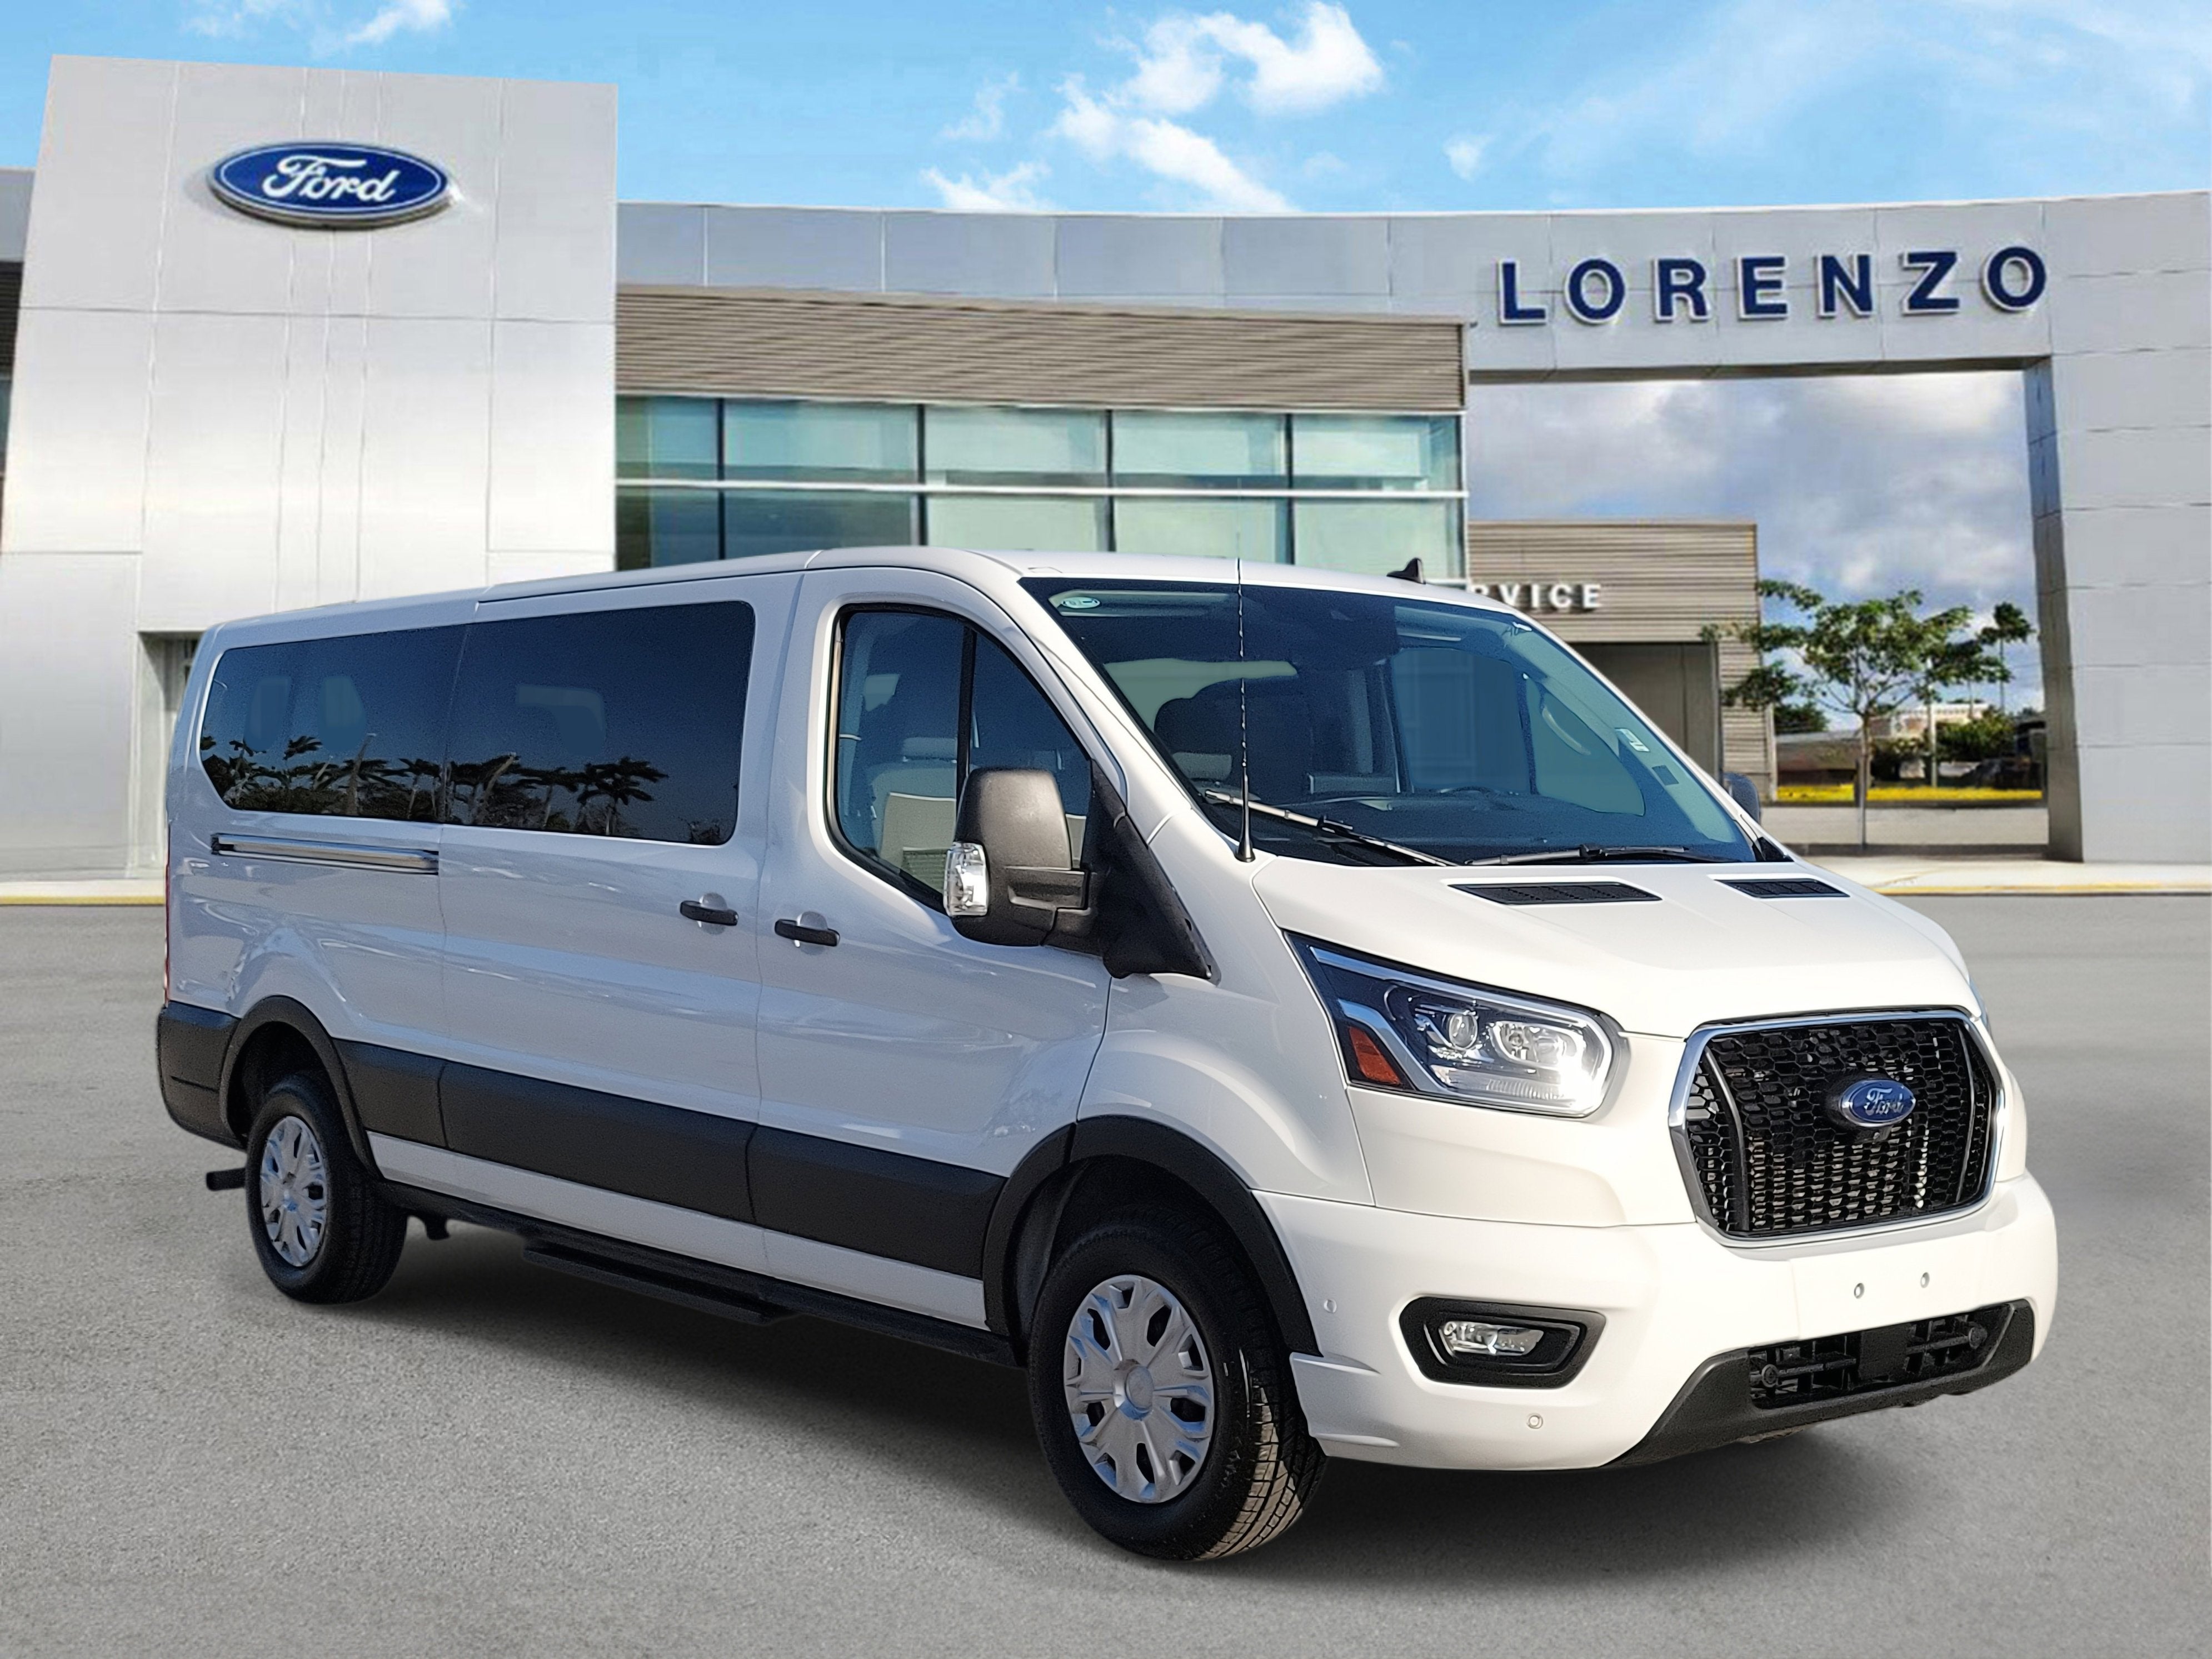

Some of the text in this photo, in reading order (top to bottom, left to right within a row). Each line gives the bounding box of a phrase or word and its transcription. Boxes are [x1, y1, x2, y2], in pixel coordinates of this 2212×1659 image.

[262, 154, 400, 202] Ford
[1498, 247, 2047, 324] LORENZO
[1864, 1087, 1904, 1116] Ford
